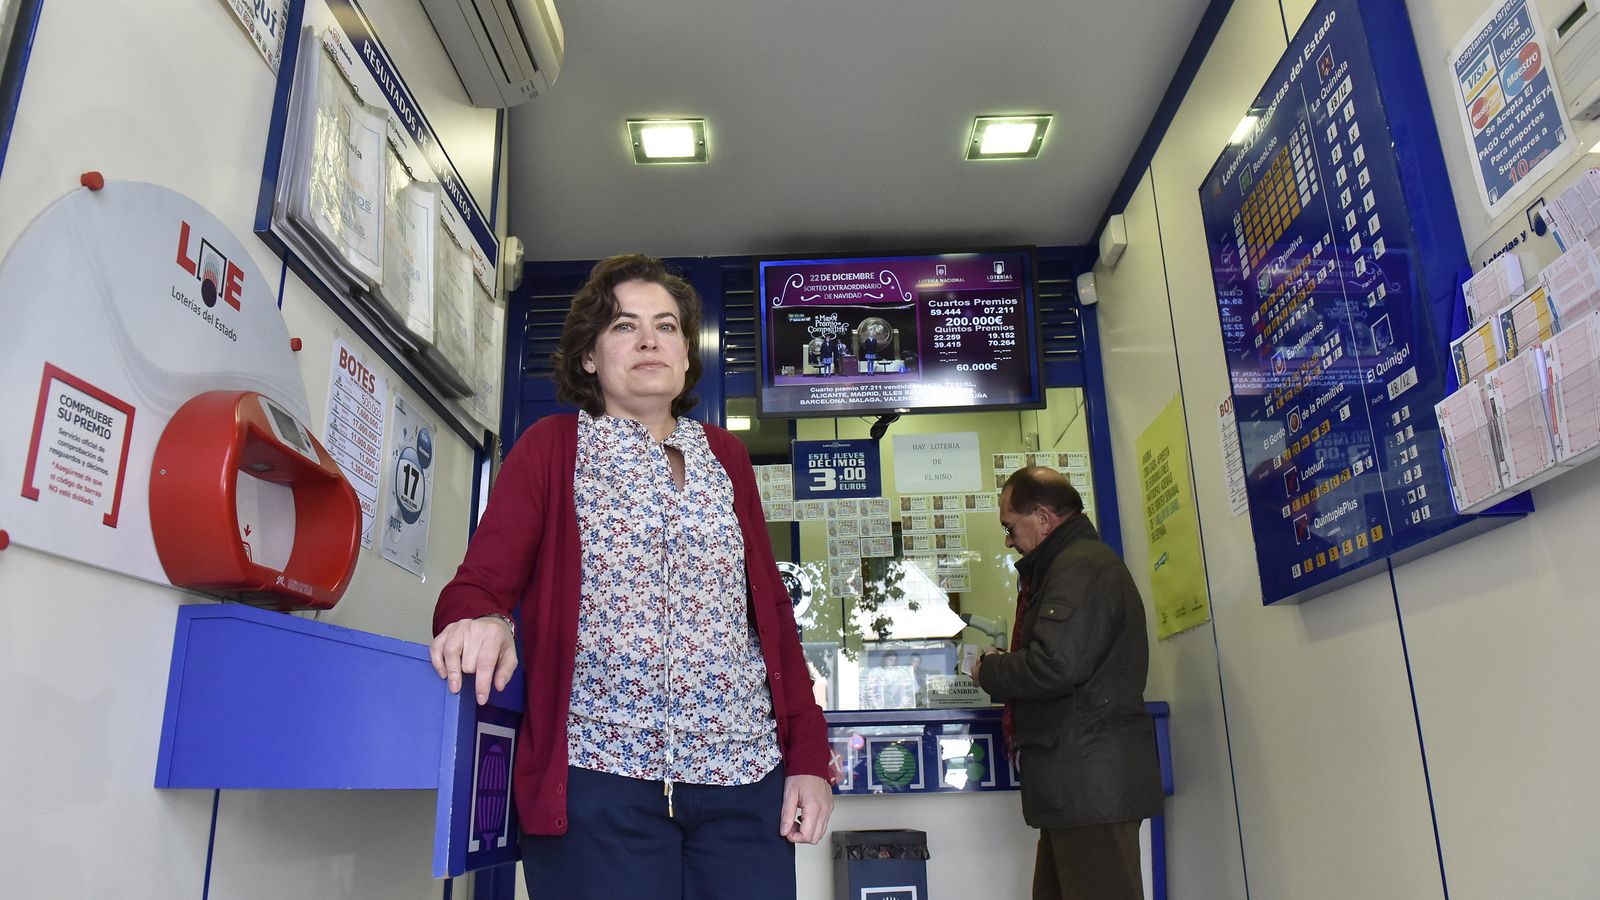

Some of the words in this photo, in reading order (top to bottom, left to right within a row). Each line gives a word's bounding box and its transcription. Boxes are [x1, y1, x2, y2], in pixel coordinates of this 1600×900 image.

[1501, 17, 1520, 41] VISA
[1456, 24, 1494, 70] Aceptamos
[1499, 27, 1531, 63] Electron
[1254, 81, 1290, 137] Apuestas
[1289, 56, 1304, 83] del
[1303, 9, 1337, 62] Estado
[1467, 61, 1488, 90] VISA
[1506, 51, 1539, 89] Maestro
[1311, 98, 1321, 113] La
[1320, 60, 1348, 101] Quiniela
[1329, 82, 1348, 114] 18/12
[1479, 136, 1499, 161] PAGO
[1500, 122, 1515, 140] con
[1514, 84, 1553, 123] TARJETA
[1485, 124, 1496, 137] Se
[1496, 96, 1524, 127] Acepta
[1524, 84, 1534, 98] El
[363, 39, 416, 132] RESULTADOS
[417, 124, 428, 147] DE
[443, 170, 472, 222] SORTEOS
[1490, 145, 1508, 166] Para
[1508, 111, 1545, 149] Importes
[1252, 136, 1278, 174] BonoLoto
[1498, 133, 1540, 175] Superiores
[1541, 127, 1548, 136] a
[1508, 158, 1530, 185] 10
[1520, 229, 1527, 243] y
[1271, 263, 1279, 275] La
[1278, 235, 1303, 267] Primitiva
[810, 274, 820, 282] 22
[820, 273, 832, 281] DE
[832, 272, 875, 281] DICIEMBRE
[828, 283, 882, 291] EXTRAORDINARIO
[833, 292, 863, 300] NAVIDAD
[974, 298, 1018, 306] Premios
[930, 308, 962, 316] 59.444
[984, 306, 1014, 314] 07.211
[945, 315, 1004, 327] 200.000€
[202, 309, 214, 325] del
[215, 317, 237, 342] Estado
[975, 324, 1015, 332] Premios
[988, 332, 1015, 340] 19.152
[934, 341, 962, 349] 39.415
[1286, 321, 1324, 360] EuroMillones
[339, 346, 376, 394] BOTES
[956, 363, 998, 372] 60.000€
[1366, 368, 1376, 384] El
[1376, 342, 1410, 377] Quinigol
[1390, 373, 1411, 397] 18/12
[60, 394, 114, 428] COMPRUEBE
[800, 397, 846, 406] BARCELONA,
[849, 396, 884, 404] MALAGA,
[57, 407, 72, 422] SU
[73, 414, 112, 440] PREMIO
[1263, 438, 1270, 451] El
[1269, 427, 1286, 446] Gordo
[1301, 409, 1310, 420] de
[1310, 401, 1317, 414] la
[1315, 382, 1345, 409] Primitiva
[58, 427, 80, 443] Servicio
[81, 439, 97, 450] oficial
[912, 443, 926, 451] HAY
[930, 442, 960, 450] LOTERIA
[49, 447, 81, 464] resguardos
[808, 453, 831, 461] ESTE
[832, 452, 865, 460] JUEVES
[403, 463, 421, 501] 17
[808, 467, 867, 492] 3,00
[1301, 456, 1325, 482] Lototurf
[48, 484, 58, 493] NO
[84, 485, 102, 498] barras
[92, 478, 103, 487] que
[839, 482, 867, 491] EUROS
[1313, 499, 1358, 529] QuintuplePlus
[948, 688, 979, 696] CAMBIOS
